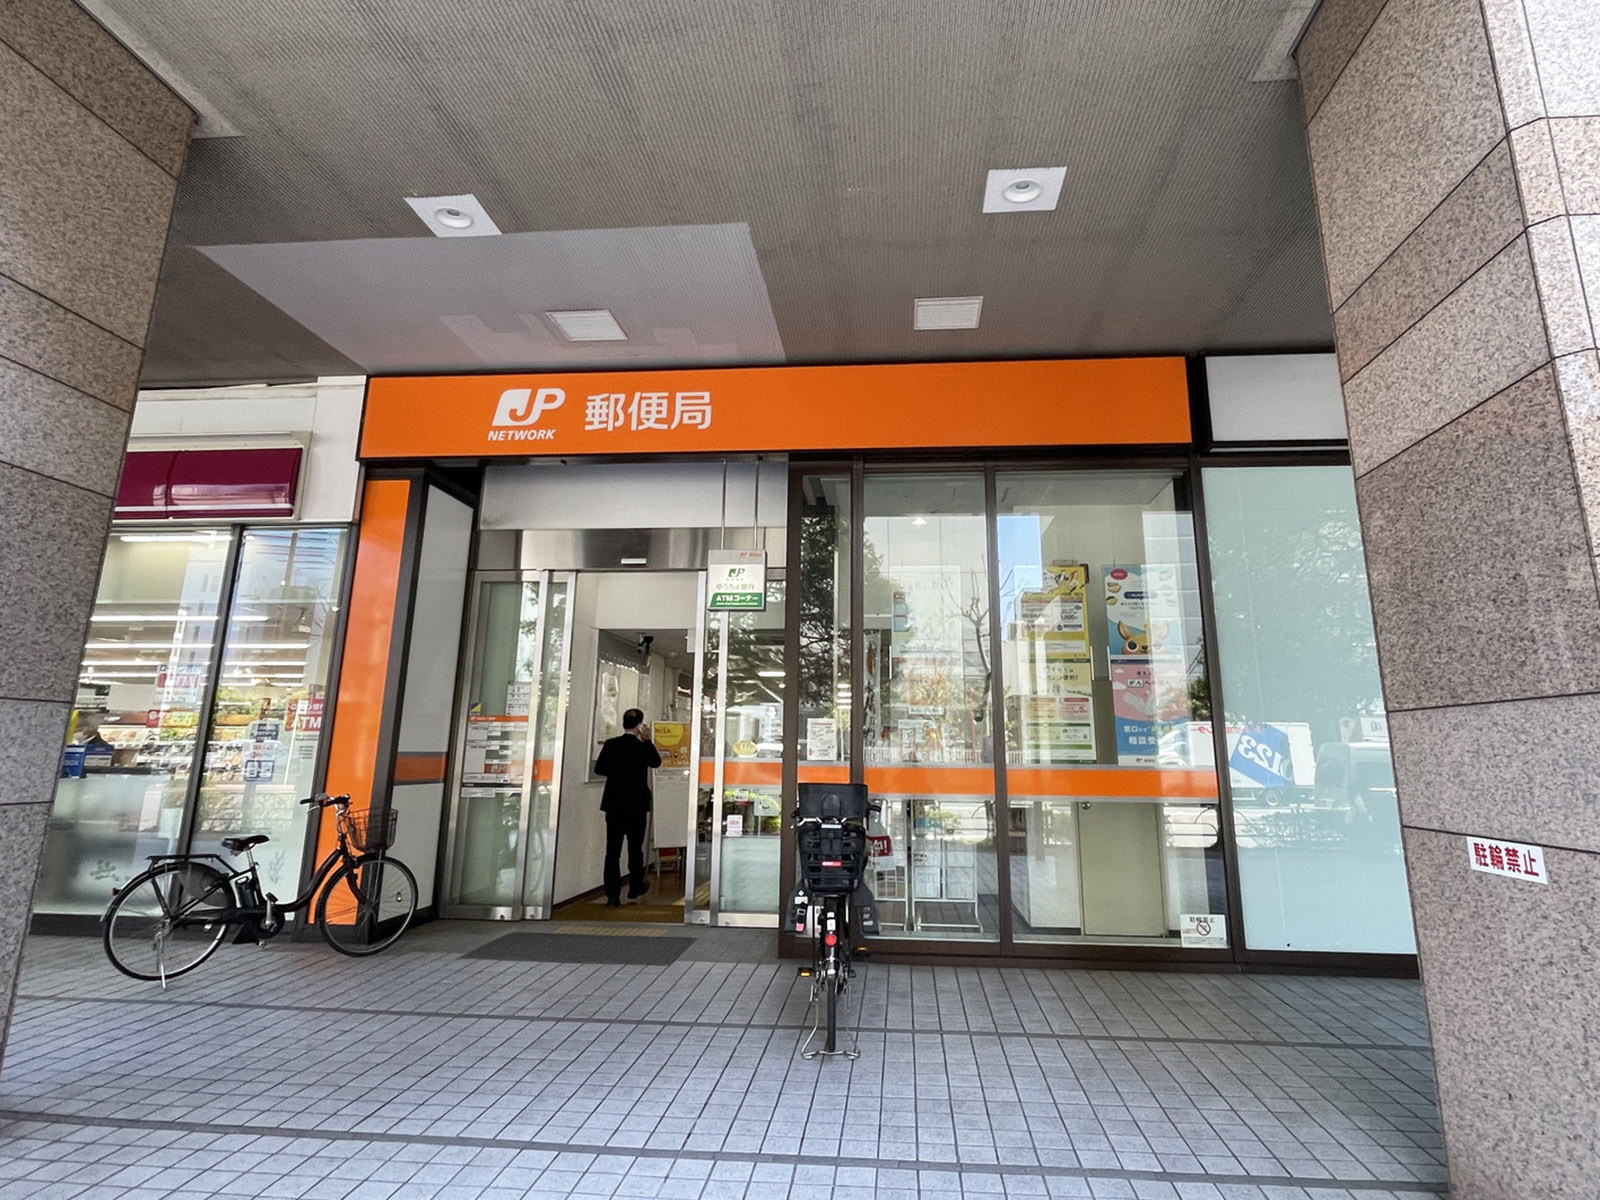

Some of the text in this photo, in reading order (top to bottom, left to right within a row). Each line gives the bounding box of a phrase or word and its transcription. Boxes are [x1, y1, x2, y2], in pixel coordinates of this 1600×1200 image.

[492, 388, 566, 426] JP
[584, 391, 712, 431] 郵便局
[487, 429, 556, 441] NETWORK
[715, 594, 759, 602] ATMコーナー
[1473, 842, 1540, 877] 駐輪禁止
